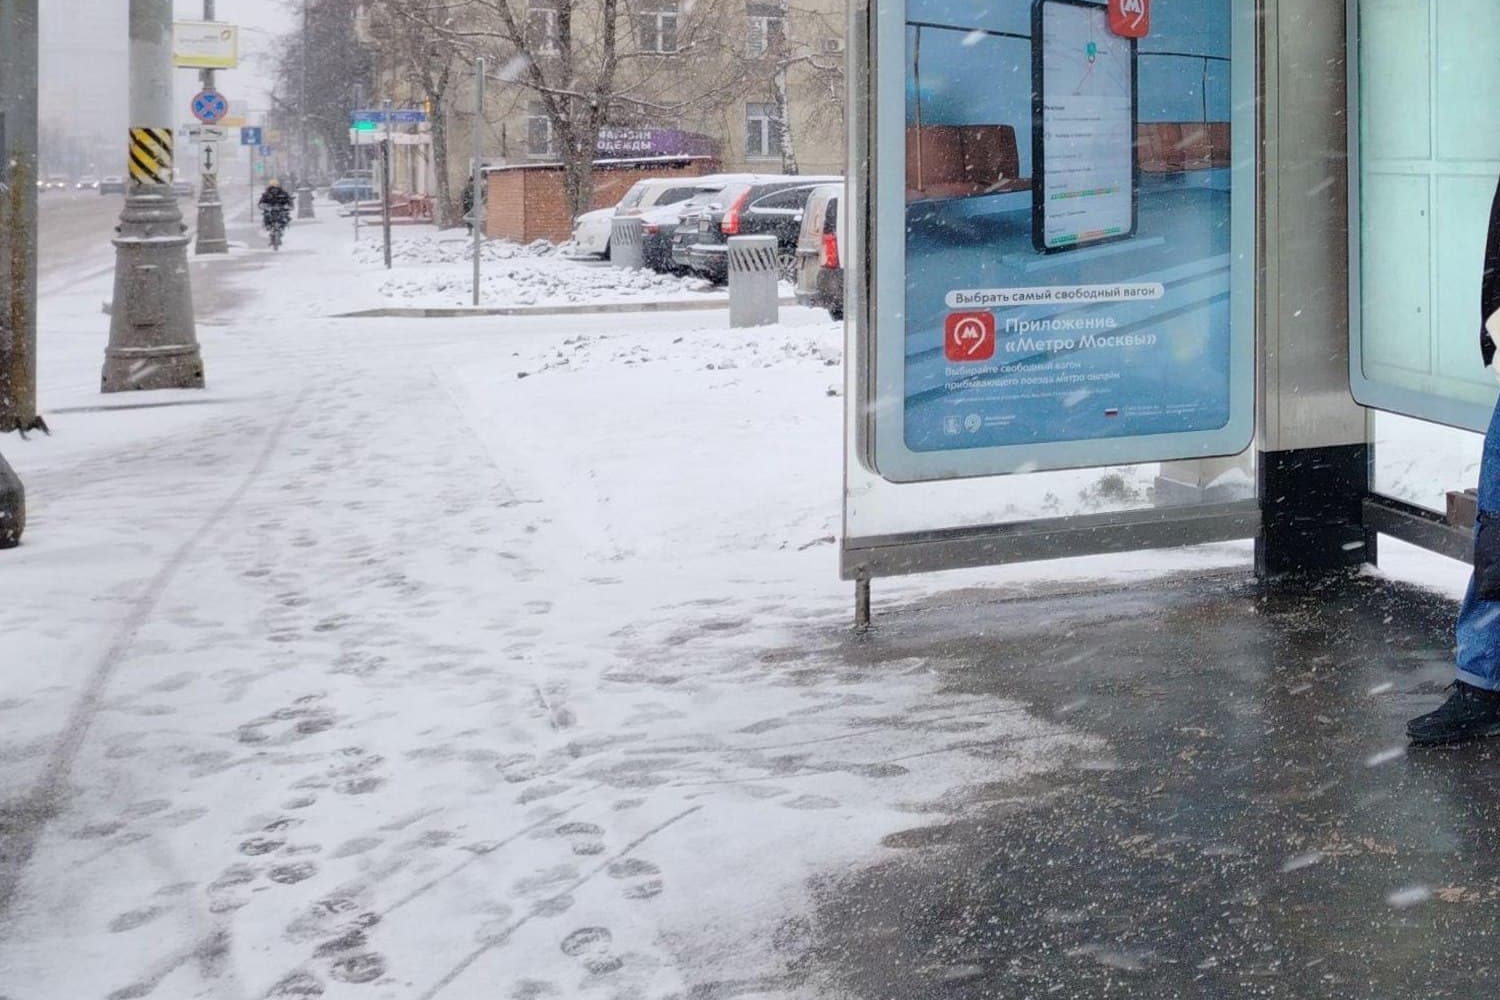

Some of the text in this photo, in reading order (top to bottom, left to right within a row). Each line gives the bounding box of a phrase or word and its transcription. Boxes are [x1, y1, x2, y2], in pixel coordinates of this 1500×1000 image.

[955, 287, 1155, 304] Выбрать самый свободный вагон
[1005, 316, 1116, 333] Приложение
[1005, 334, 1157, 353] «Метро Москвы»
